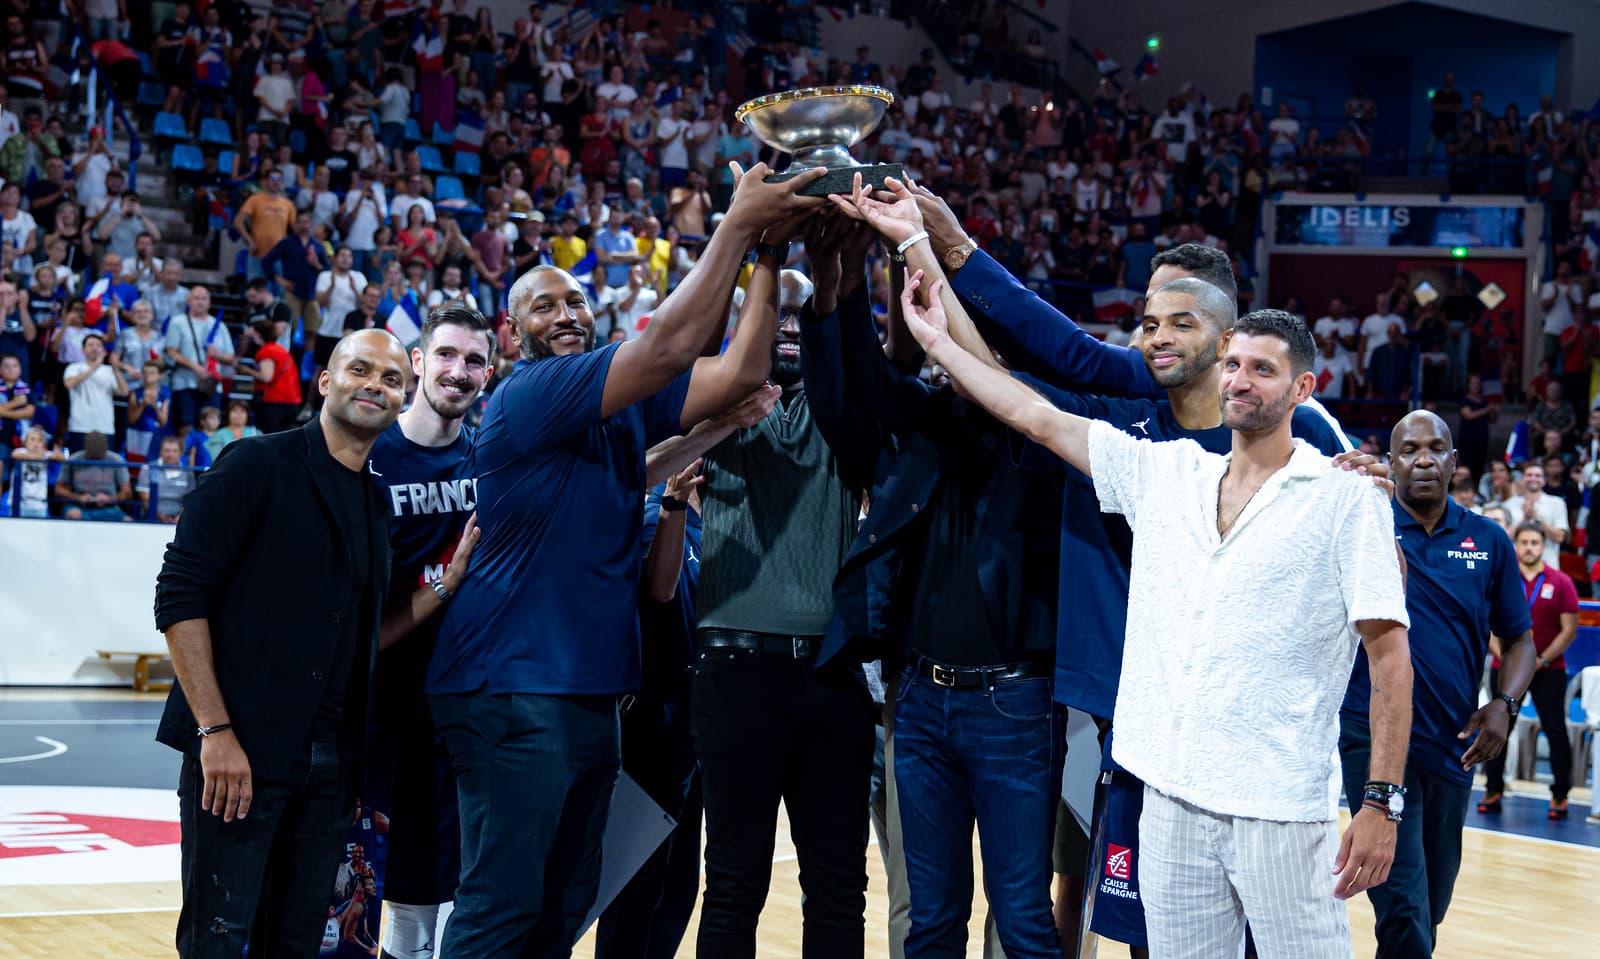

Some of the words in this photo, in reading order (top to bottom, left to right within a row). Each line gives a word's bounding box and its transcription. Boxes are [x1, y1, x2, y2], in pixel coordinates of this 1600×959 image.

[1309, 205, 1410, 227] IDELIS
[1447, 550, 1488, 560] FRANCE
[1104, 878, 1128, 890] CAISSE
